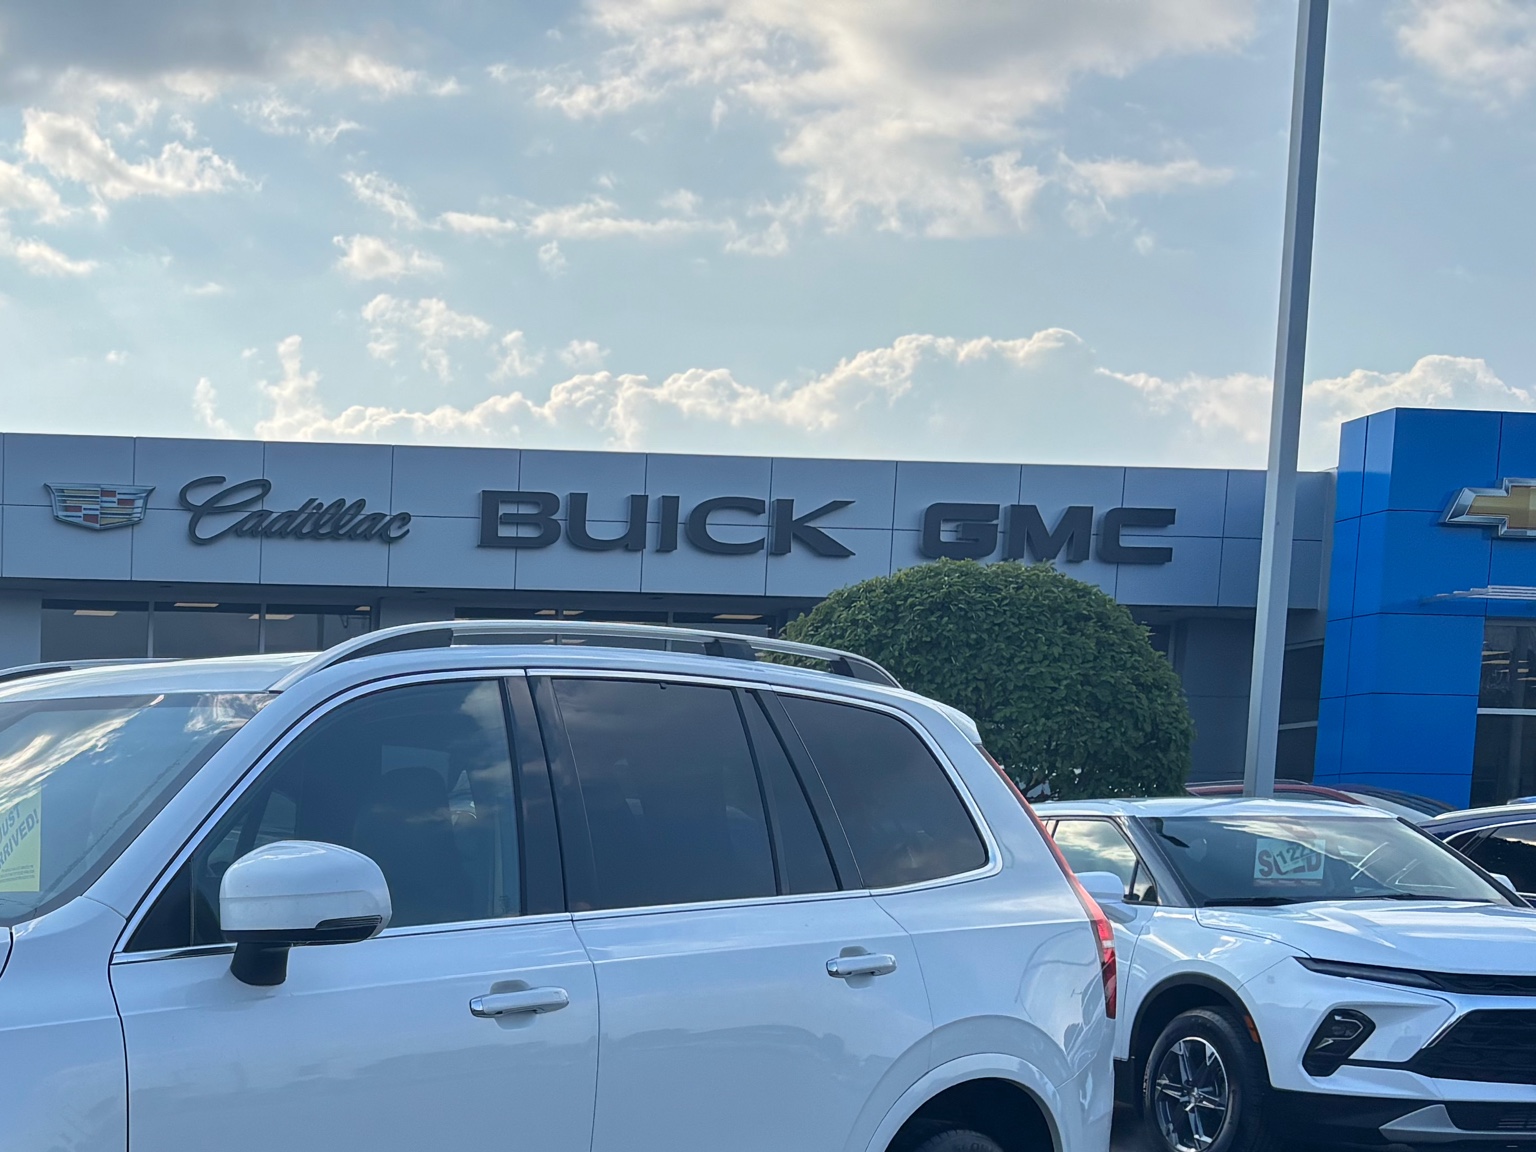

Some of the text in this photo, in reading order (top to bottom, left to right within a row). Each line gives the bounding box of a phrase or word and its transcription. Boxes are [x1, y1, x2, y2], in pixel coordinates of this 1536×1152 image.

[179, 475, 411, 546] Cadillac
[477, 489, 857, 558] BUICK
[919, 502, 1177, 566] GMC
